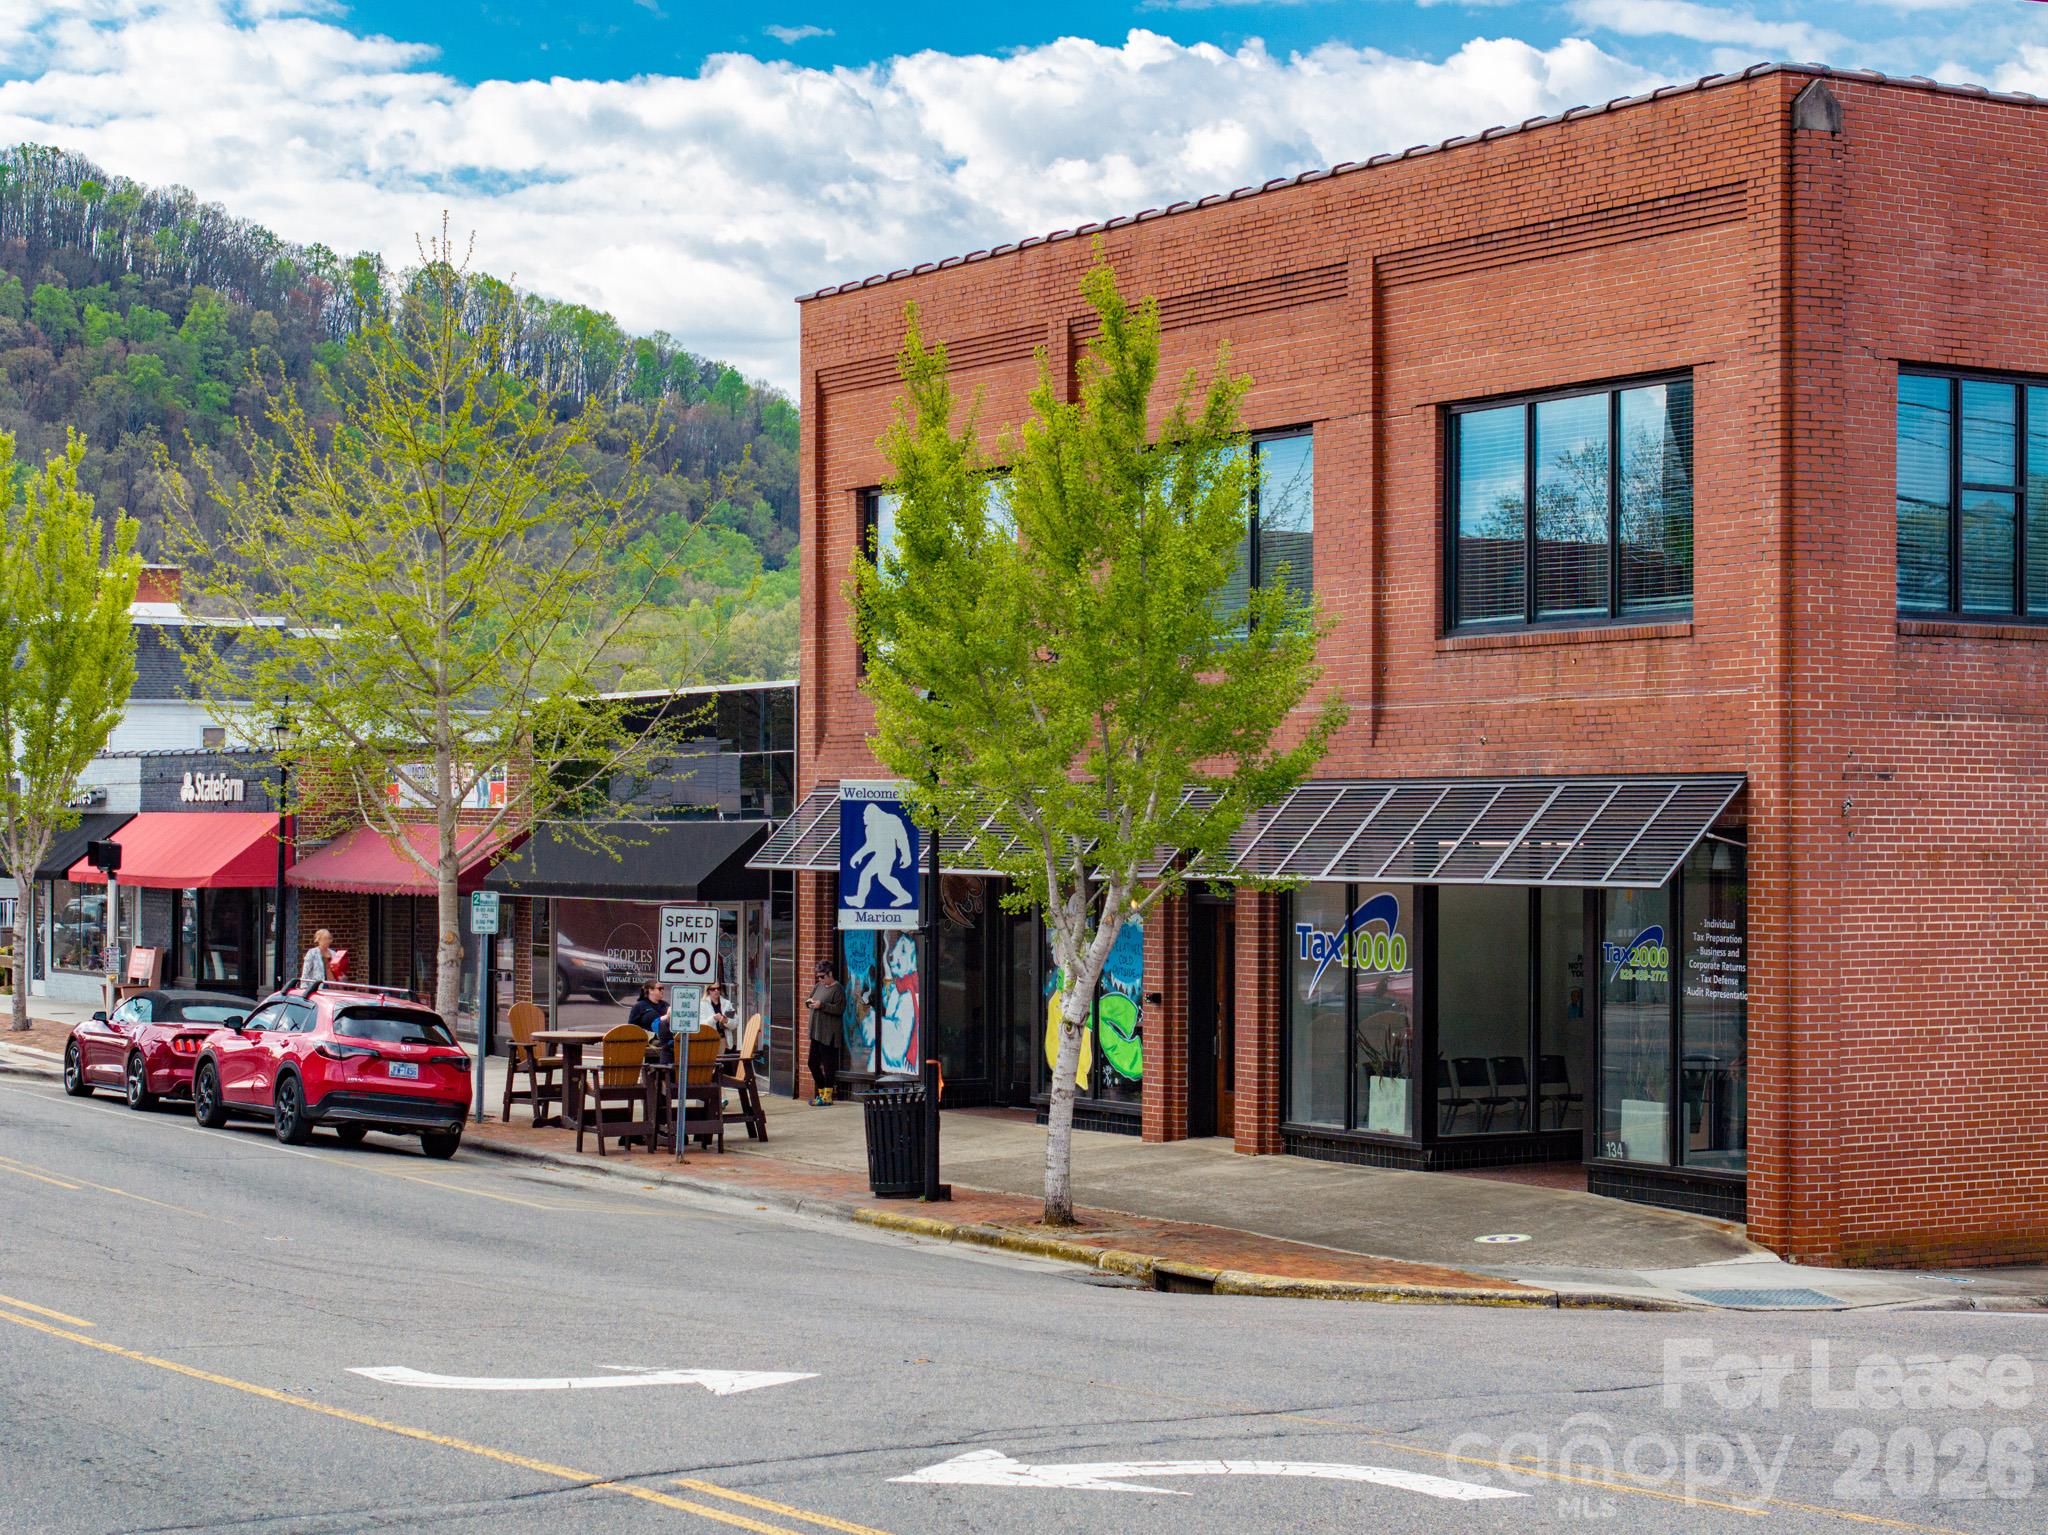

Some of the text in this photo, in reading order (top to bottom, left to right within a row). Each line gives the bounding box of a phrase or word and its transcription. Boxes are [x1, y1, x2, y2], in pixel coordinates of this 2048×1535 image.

[843, 787, 900, 799] Welcome
[665, 915, 714, 928] SPEED
[855, 911, 902, 922] Marion
[1703, 919, 1736, 930] Individual
[669, 932, 708, 943] LIMIT
[1692, 931, 1743, 945] Tax Preparation
[607, 948, 653, 963] PEOPLES
[1699, 946, 1740, 958] Business and
[664, 946, 711, 975] 20
[1688, 959, 1747, 973] Corporate Returns
[1700, 974, 1739, 986] Tax Defense
[1687, 987, 1749, 1000] Audit Representatio
[1606, 1141, 1623, 1158] 134
